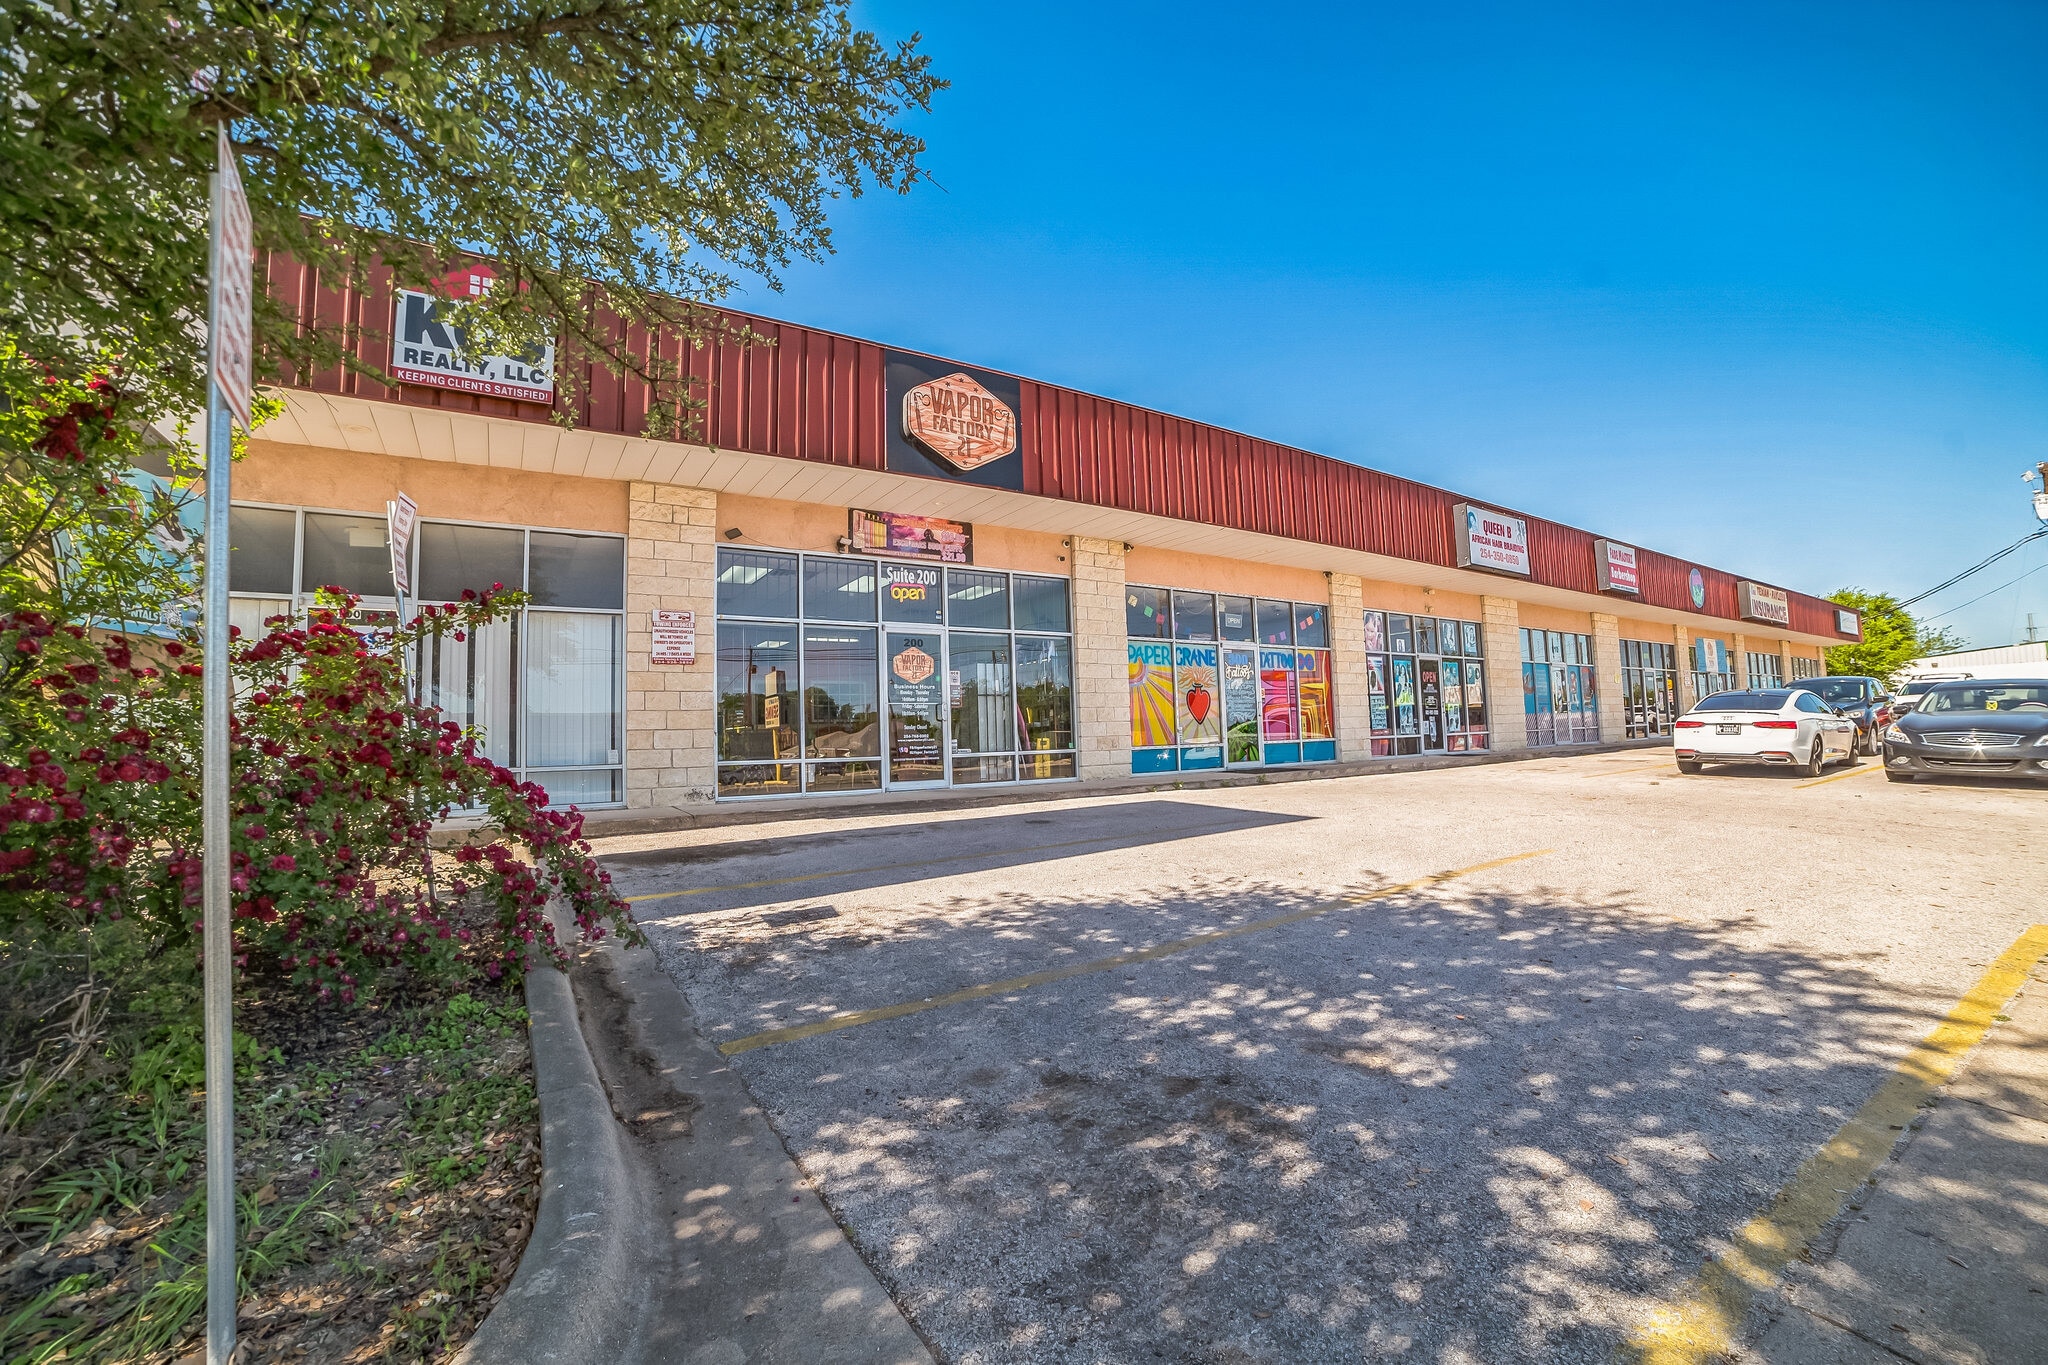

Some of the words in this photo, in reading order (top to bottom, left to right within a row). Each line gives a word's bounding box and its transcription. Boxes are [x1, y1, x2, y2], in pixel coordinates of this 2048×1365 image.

[504, 364, 545, 385] LLC
[397, 369, 446, 386] KEEPING
[447, 376, 492, 393] CLIENTS
[494, 384, 549, 401] SATISFIED!
[930, 386, 994, 424] VAPOR
[932, 414, 994, 440] FACTORY
[1483, 519, 1505, 537] QUEEN
[1507, 526, 1512, 539] B
[1471, 534, 1492, 546] AFRICAN
[1492, 538, 1504, 549] HAIR
[1504, 542, 1525, 554] BRAIDING
[886, 566, 915, 584] Suite
[916, 569, 937, 585] 200
[890, 587, 926, 603] open
[1751, 599, 1786, 621] INSURANCE
[903, 638, 924, 648] 200
[901, 655, 926, 665] VAPOR
[1128, 644, 1171, 666] PAPER
[1175, 647, 1217, 668] CRANE
[1259, 651, 1294, 669] TATTOO
[1422, 671, 1437, 683] OPEN
